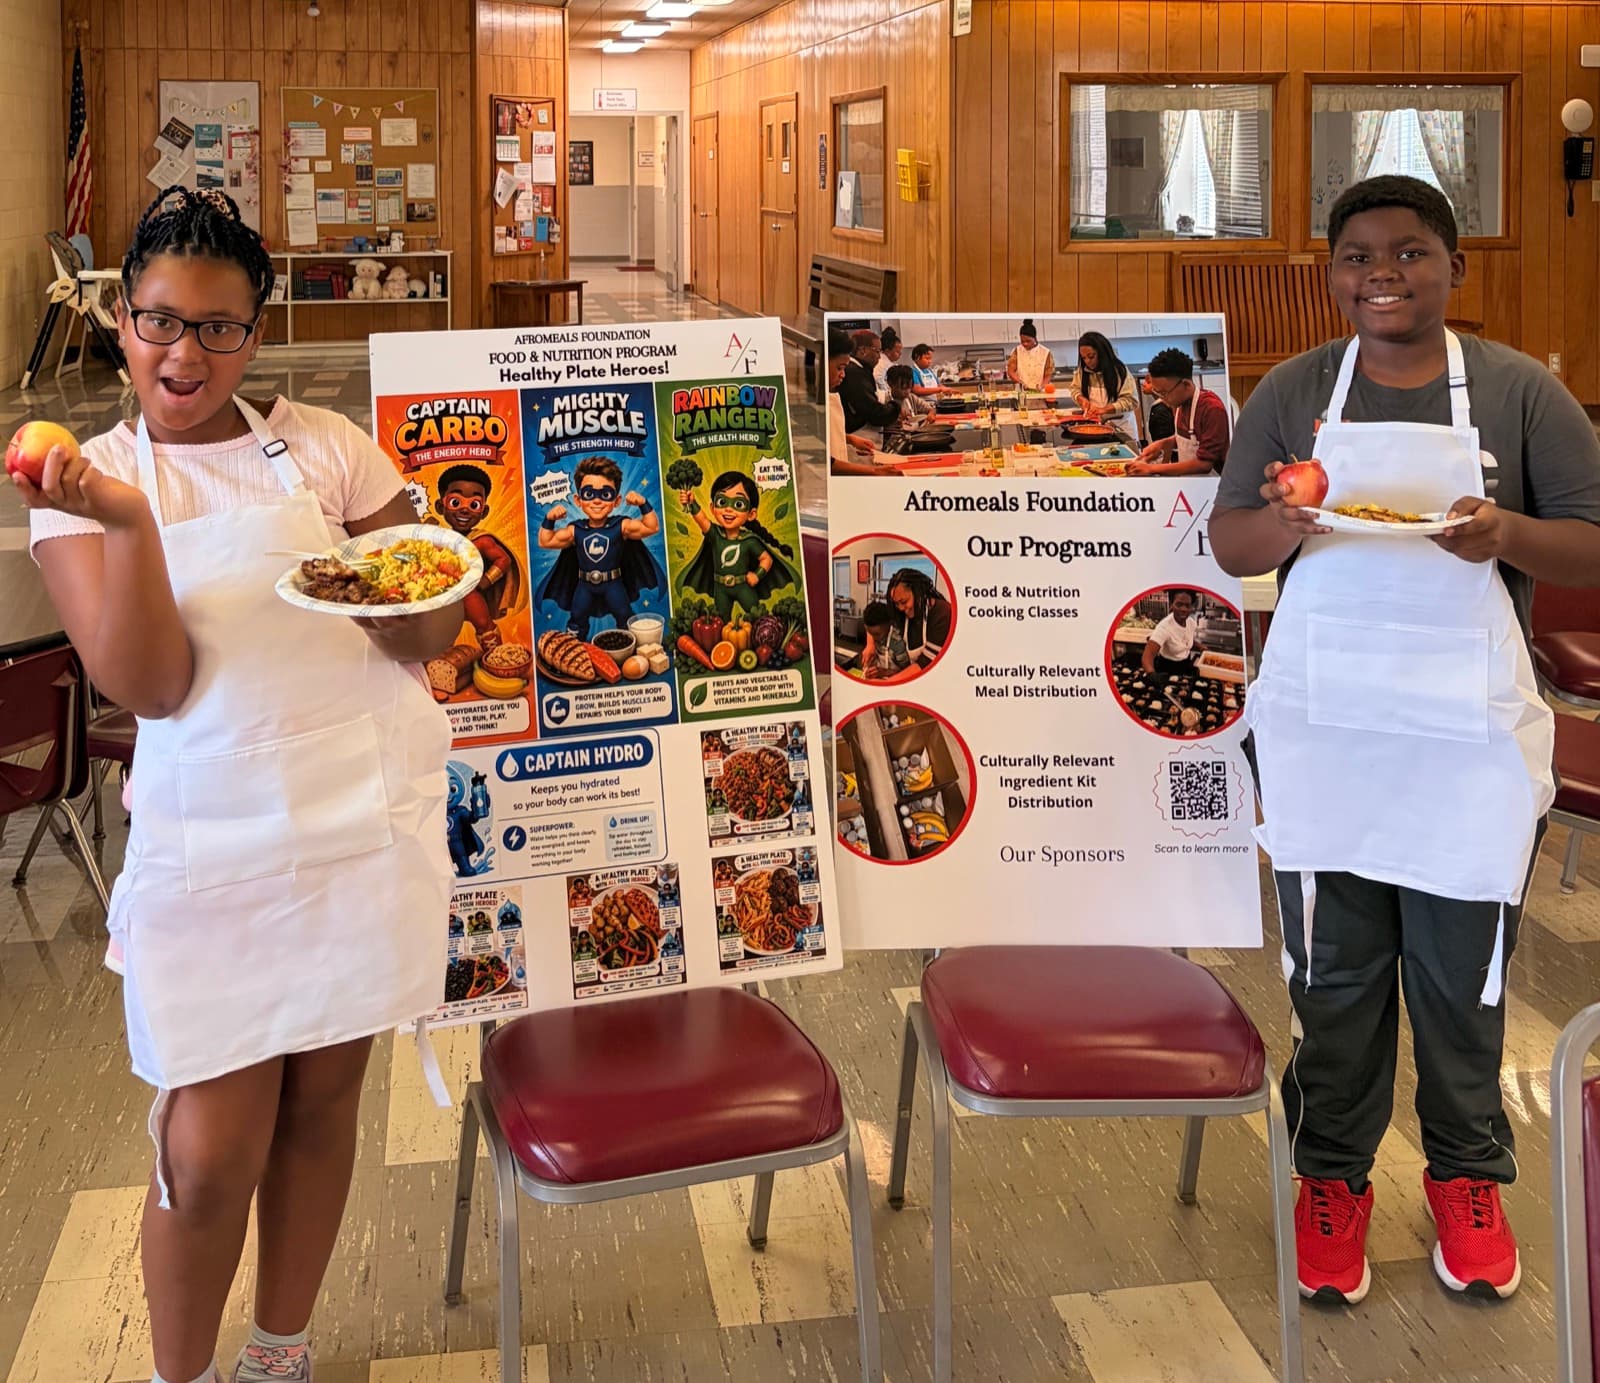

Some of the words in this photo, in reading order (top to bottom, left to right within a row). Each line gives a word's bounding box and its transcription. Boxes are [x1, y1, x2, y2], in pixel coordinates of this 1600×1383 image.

[514, 331, 579, 346] AFROMEALS
[581, 329, 651, 342] FOUNDATION
[489, 351, 527, 365] FOOD
[529, 351, 539, 364] &
[542, 347, 614, 363] NUTRITION
[616, 344, 678, 359] PROGRAM
[500, 366, 562, 384] Healthy
[566, 362, 607, 380] Plate
[610, 360, 670, 377] Heroes!
[553, 392, 630, 414] MIGHTY
[673, 386, 777, 413] RAINBOW
[407, 398, 491, 420] CAPTAIN
[538, 408, 648, 442] MUSCLE
[675, 406, 775, 436] RANGER
[395, 415, 507, 451] CARBO
[692, 436, 708, 447] THE
[708, 434, 738, 445] HEALTH
[739, 434, 760, 442] HERO
[554, 444, 571, 454] THE
[572, 439, 613, 452] STRENGTH
[614, 438, 635, 449] HERO
[416, 450, 432, 462] THE
[434, 448, 468, 460] ENERGY
[469, 446, 492, 457] HERO
[760, 466, 770, 474] EAT
[534, 483, 548, 492] GROW
[548, 478, 568, 488] STRONG
[757, 474, 788, 482] RAINBOW!
[538, 488, 554, 499] EVERY
[555, 486, 568, 496] DAY!
[904, 490, 1019, 512] Afromeals
[1025, 490, 1156, 512] Foundation
[967, 535, 1014, 558] Our
[1020, 536, 1132, 563] Programs
[964, 586, 998, 598] Food
[1002, 586, 1012, 598] &
[1016, 586, 1081, 598] Nutrition
[968, 606, 1024, 621] Cooking
[1028, 606, 1078, 618] Classes
[966, 664, 1036, 681] Culturally
[1039, 664, 1101, 678] Relevant
[712, 680, 734, 688] FRUITS
[736, 678, 749, 686] AND
[750, 674, 788, 684] VEGETABLES
[574, 693, 603, 702] PROTEIN
[604, 690, 624, 700] HELPS
[626, 688, 644, 698] YOUR
[645, 686, 662, 695] BODY
[714, 688, 741, 696] PROTECT
[742, 686, 759, 694] YOUR
[760, 684, 777, 692] BODY
[778, 682, 794, 690] WITH
[975, 685, 1010, 698] Meal
[1013, 685, 1098, 698] Distribution
[575, 702, 596, 712] GROW,
[598, 700, 621, 710] BUILDS
[622, 696, 651, 706] MUSCLES
[652, 695, 666, 704] AND
[714, 696, 747, 706] VITAMINS
[748, 694, 760, 703] AND
[762, 692, 798, 702] MINERALS!
[490, 704, 505, 712] GIVE
[506, 702, 520, 710] YOU
[576, 710, 602, 720] REPAIRS
[604, 709, 622, 718] YOUR
[622, 706, 642, 716] BODY!
[462, 716, 471, 724] TO
[472, 714, 488, 724] RUN,
[490, 712, 508, 722] PLAY,
[458, 724, 473, 733] AND
[475, 722, 498, 731] THINK!
[725, 730, 731, 738] A
[732, 726, 758, 736] HEALTHY
[524, 746, 591, 772] CAPTAIN
[594, 742, 645, 766] HYDRO
[980, 754, 1050, 770] Culturally
[1052, 755, 1115, 767] Relevant
[530, 784, 560, 796] Keeps
[561, 783, 579, 794] you
[580, 776, 620, 793] hydrated
[999, 775, 1074, 790] Ingredient
[1077, 775, 1097, 788] Kit
[524, 801, 545, 813] your
[546, 796, 568, 811] body
[570, 796, 585, 804] can
[586, 792, 608, 802] work
[608, 791, 619, 800] its
[620, 788, 641, 798] best!
[1008, 796, 1094, 808] Distribution
[620, 817, 638, 825] DRINK
[1000, 846, 1036, 863] Our
[1041, 846, 1126, 867] Sponsors
[1154, 844, 1178, 854] Scan
[1181, 844, 1191, 854] to
[1194, 844, 1220, 854] learn
[1222, 846, 1250, 854] more
[746, 852, 769, 862] HEALTHY
[601, 870, 629, 880] HEALTHY
[630, 868, 650, 876] PLATE
[475, 890, 498, 900] PLATE
